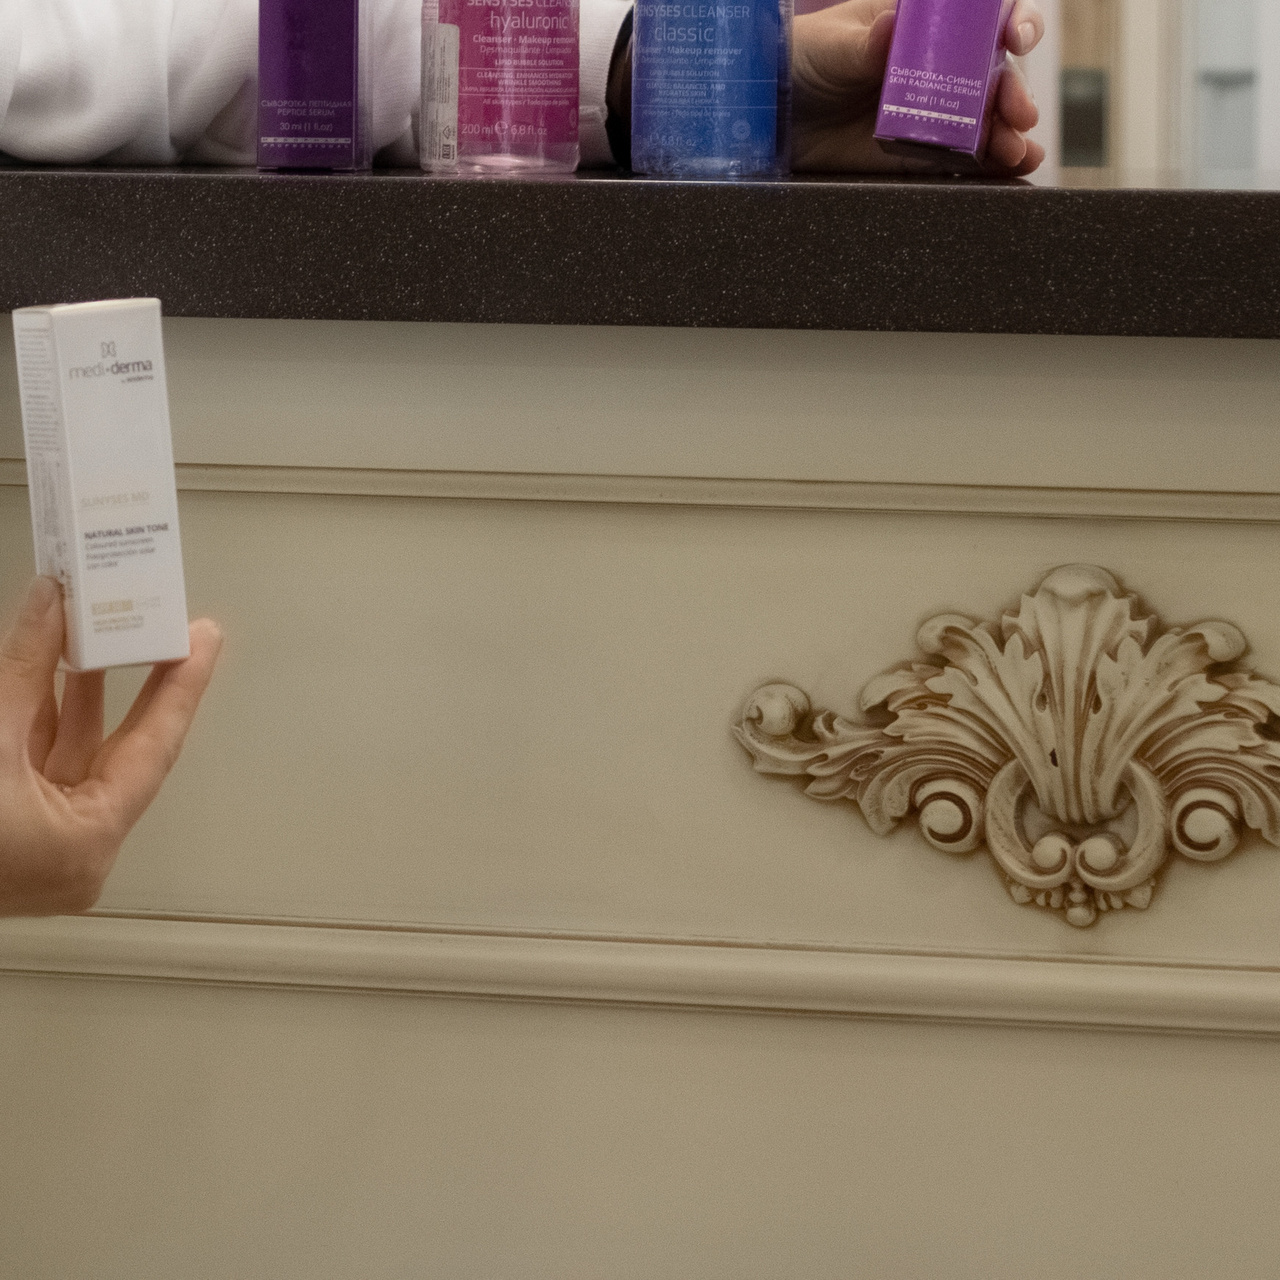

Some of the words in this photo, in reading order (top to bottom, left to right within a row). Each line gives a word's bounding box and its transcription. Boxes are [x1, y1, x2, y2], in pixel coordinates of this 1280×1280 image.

[683, 5, 750, 18] CLEANSER
[490, 10, 568, 33] hyaluronic
[654, 21, 714, 42] classic
[473, 34, 512, 44] Cleanser
[519, 35, 552, 45] Makeup
[667, 46, 702, 57] Makeup
[704, 47, 743, 56] remover
[890, 66, 983, 88] СЫВОРОТКА-СИЯНИЕ
[889, 75, 906, 85] SKIN
[908, 78, 951, 92] RADIANCE
[953, 85, 981, 97] SERUM
[904, 92, 915, 102] 30
[916, 95, 927, 103] ml
[308, 108, 336, 117] SERUM
[279, 122, 290, 131] 30
[291, 123, 302, 131] ml
[461, 123, 480, 135] 200
[482, 126, 493, 135] ml
[84, 528, 123, 540] NATURAL
[125, 526, 145, 535] SKIN
[146, 522, 169, 533] TONE
